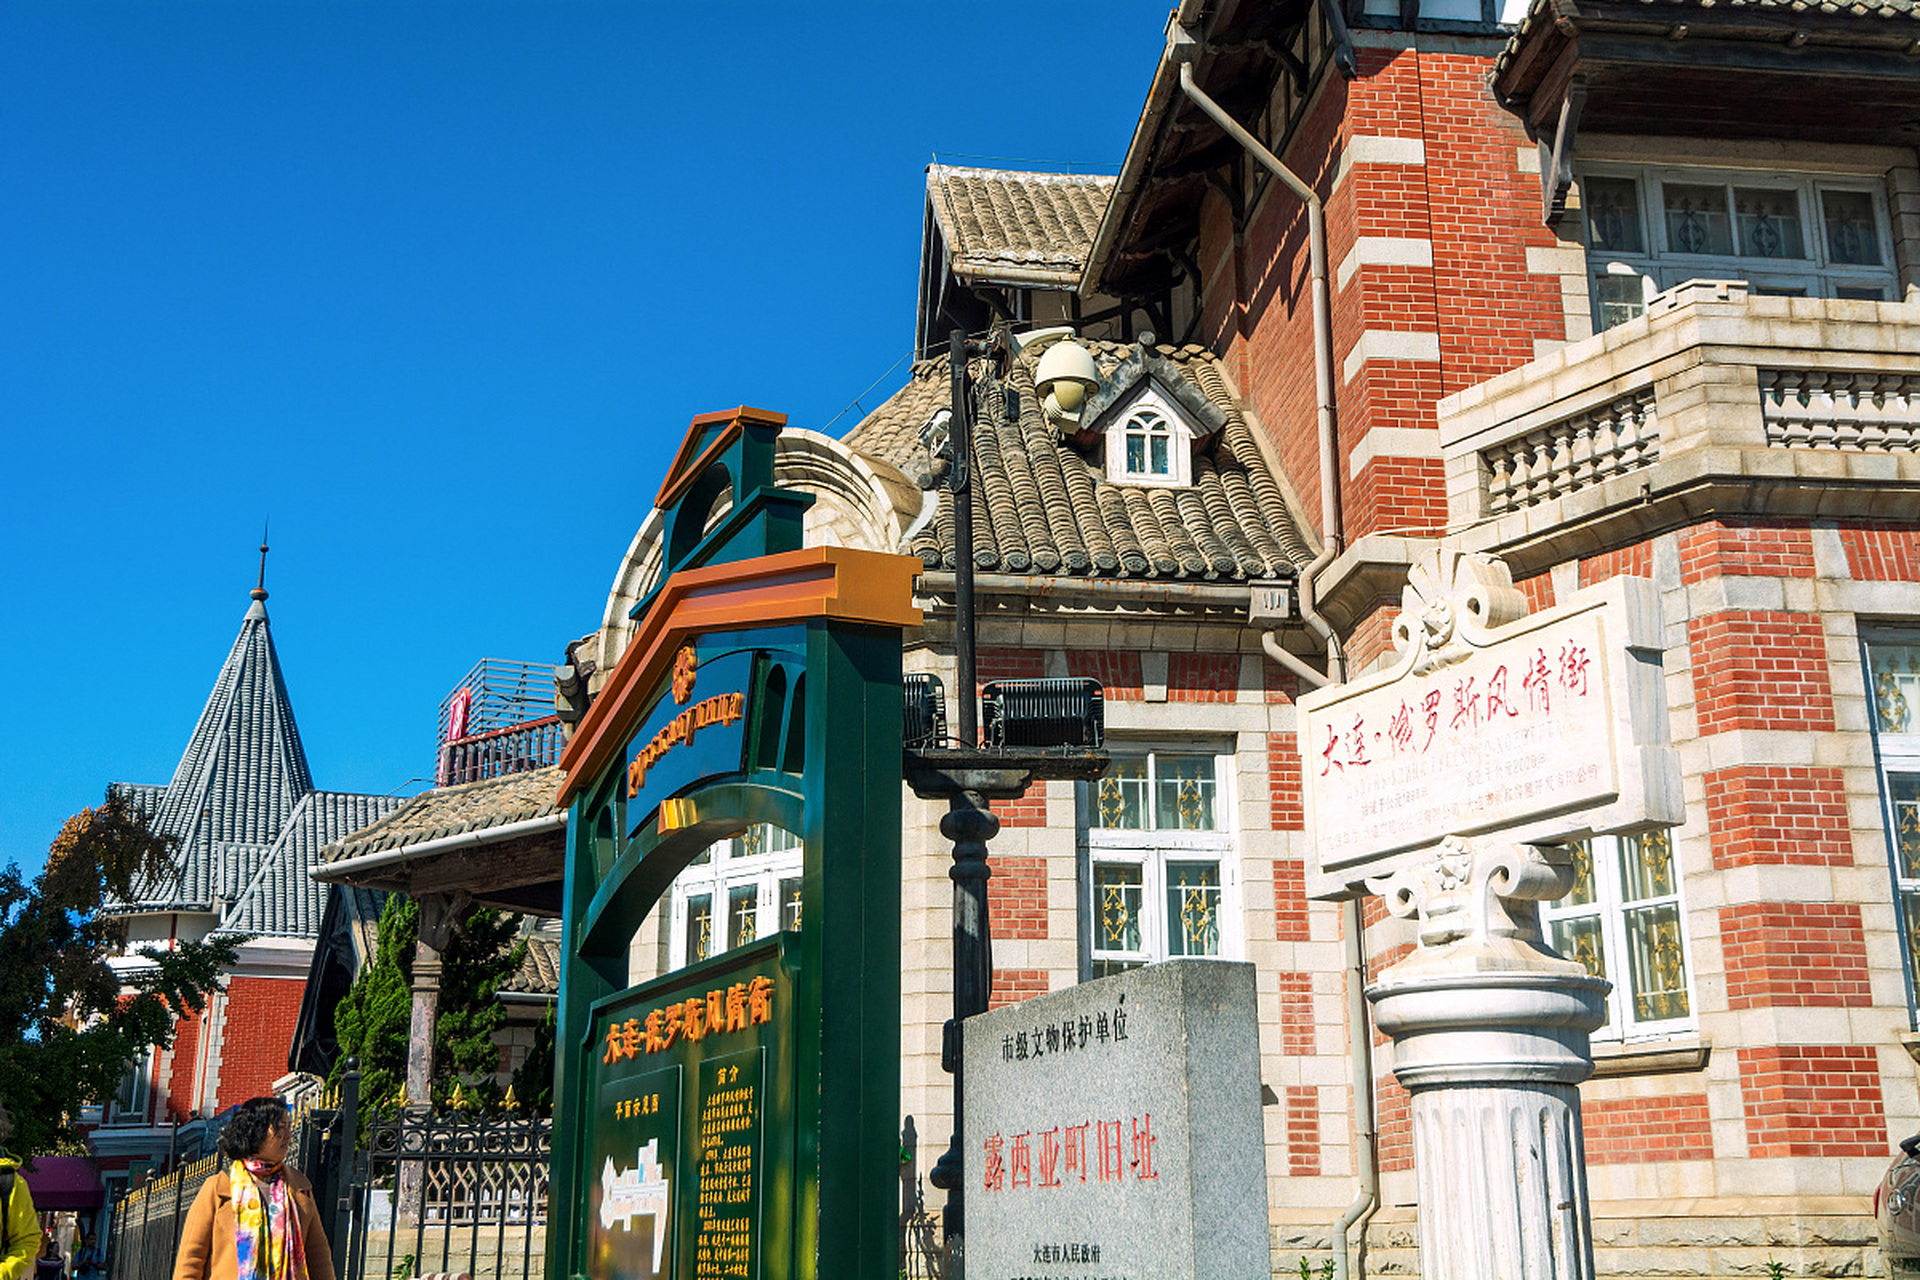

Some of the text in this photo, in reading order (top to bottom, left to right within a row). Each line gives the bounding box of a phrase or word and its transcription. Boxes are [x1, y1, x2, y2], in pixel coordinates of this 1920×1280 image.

[1001, 1007, 1129, 1064] 市级文物保护单位
[717, 1064, 740, 1086] 简介
[615, 1093, 660, 1121] 平面示意图
[983, 1112, 1159, 1192] 露西亚町旧址
[1033, 1243, 1102, 1264] 大连市人民政府
